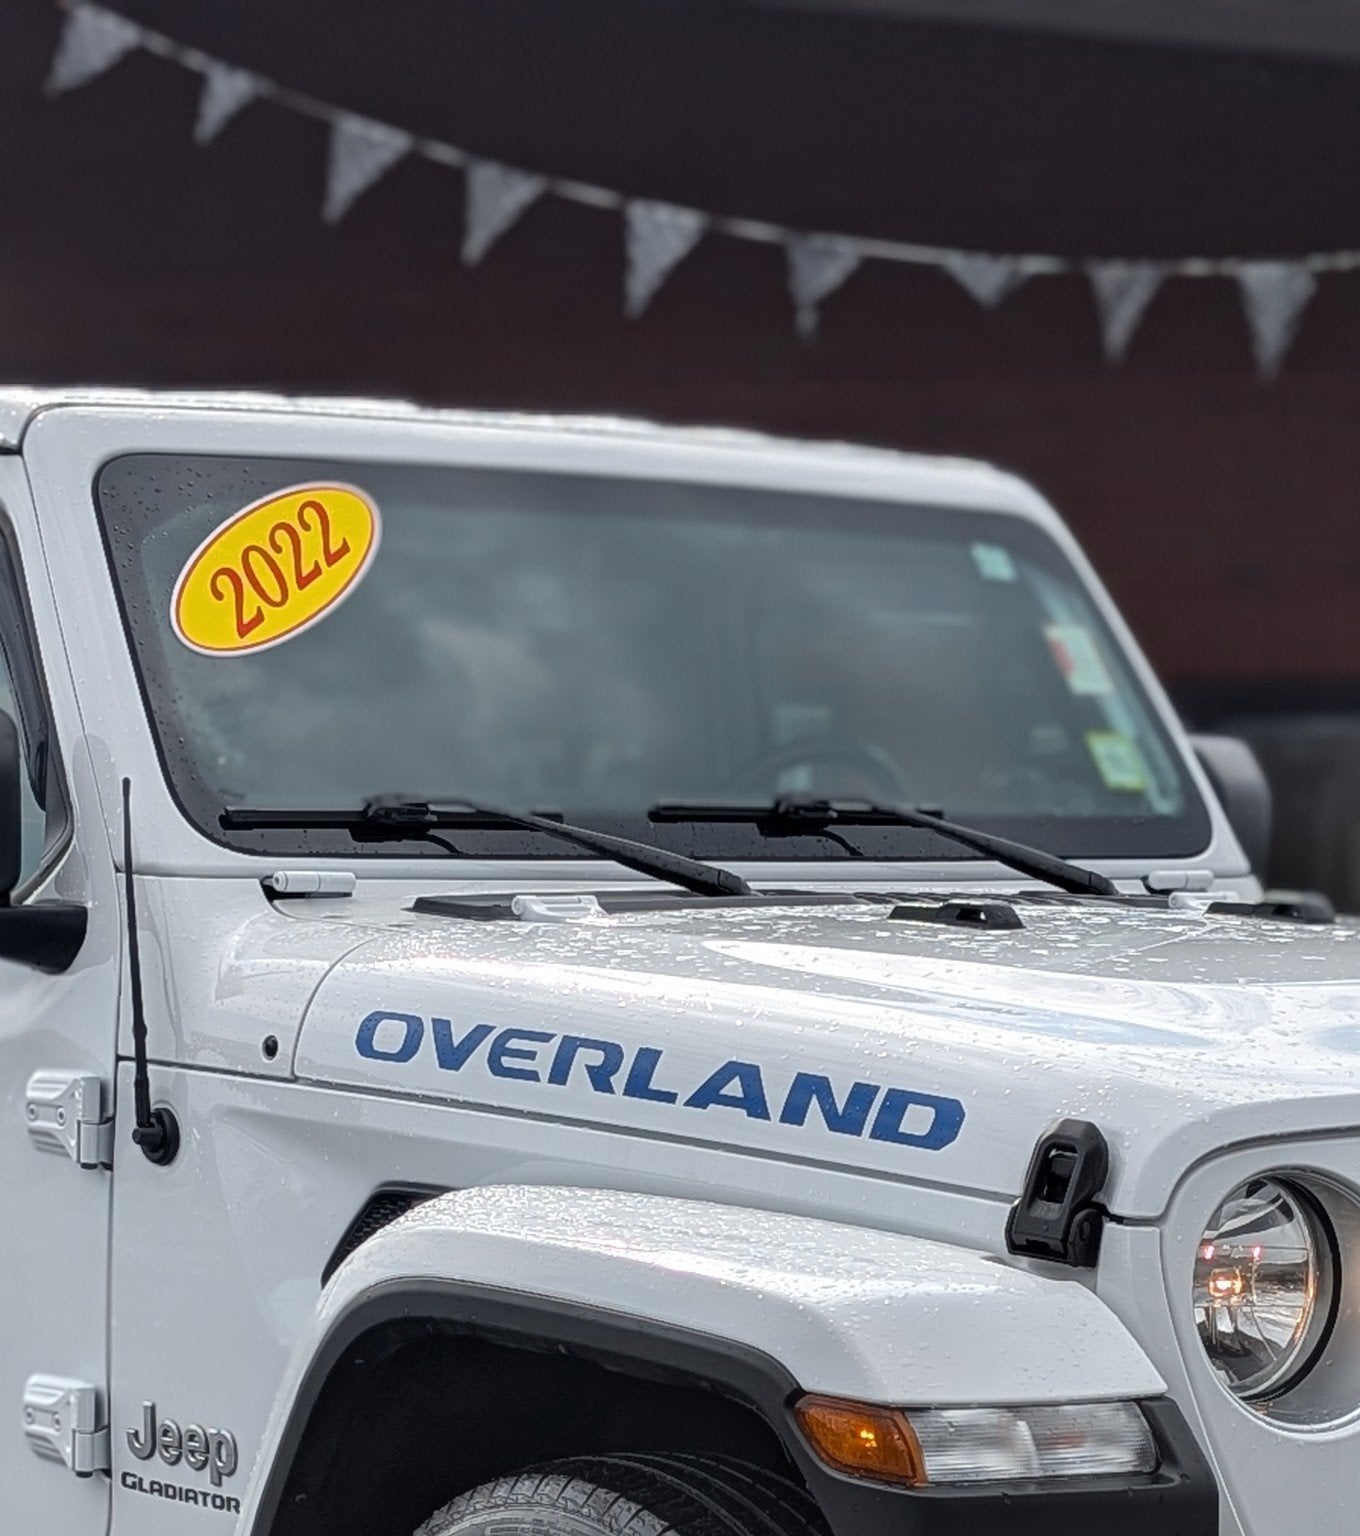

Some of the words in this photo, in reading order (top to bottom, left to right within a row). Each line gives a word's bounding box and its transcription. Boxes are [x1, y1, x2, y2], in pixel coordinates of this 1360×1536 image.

[209, 500, 351, 639] 2022
[354, 1009, 967, 1152] OVERLAND
[120, 1470, 242, 1515] GLADIATOR
[126, 1398, 239, 1488] Jeep
